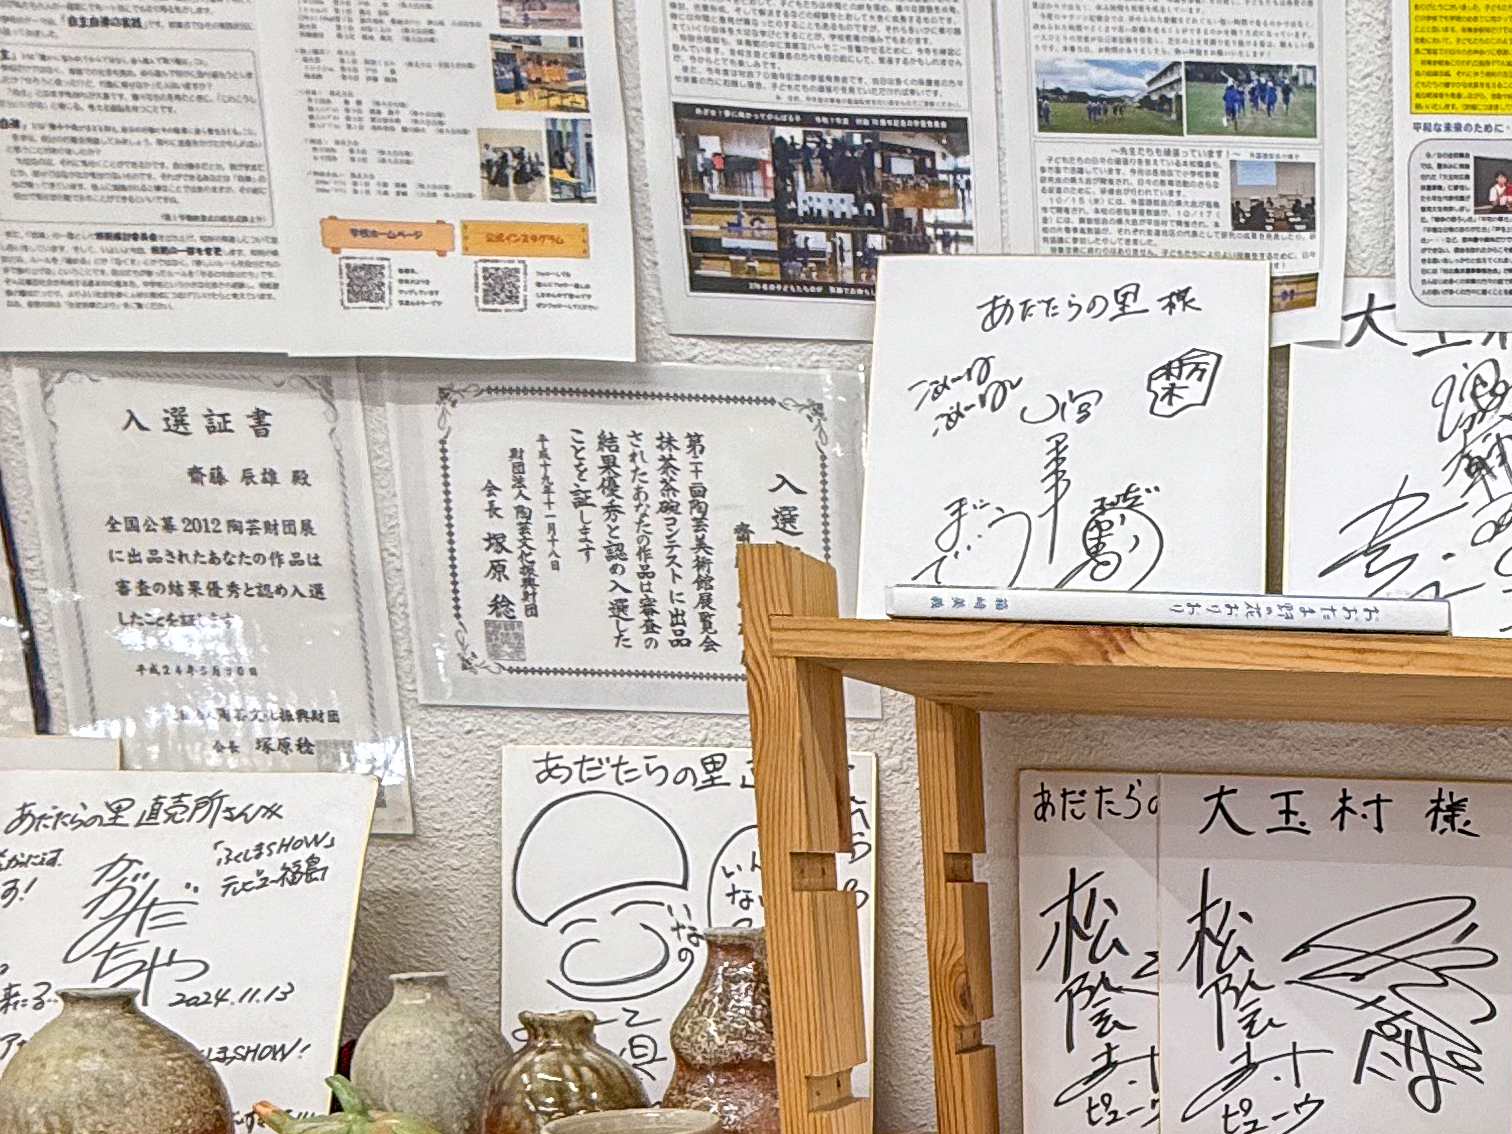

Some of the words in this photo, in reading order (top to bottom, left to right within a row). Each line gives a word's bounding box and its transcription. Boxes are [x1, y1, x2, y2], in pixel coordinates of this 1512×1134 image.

[121, 406, 274, 438] 入選証書
[291, 467, 313, 488] 殿
[569, 428, 596, 563] ことを証します
[481, 479, 504, 520] 会長
[108, 548, 323, 569] に出品されたあなたの作品は
[596, 429, 633, 650] 結果優秀と認め入選した
[626, 429, 660, 651] されたあなたの作品は審査の
[655, 430, 692, 649] 抹茶茶碗コンテストに出品
[114, 578, 328, 601] 審査の結果優秀と認め入選
[533, 751, 732, 792] あだたらの里
[1199, 786, 1393, 837] 大玉村
[1424, 787, 1481, 838] 様
[168, 982, 296, 1008] 2024.11.13
